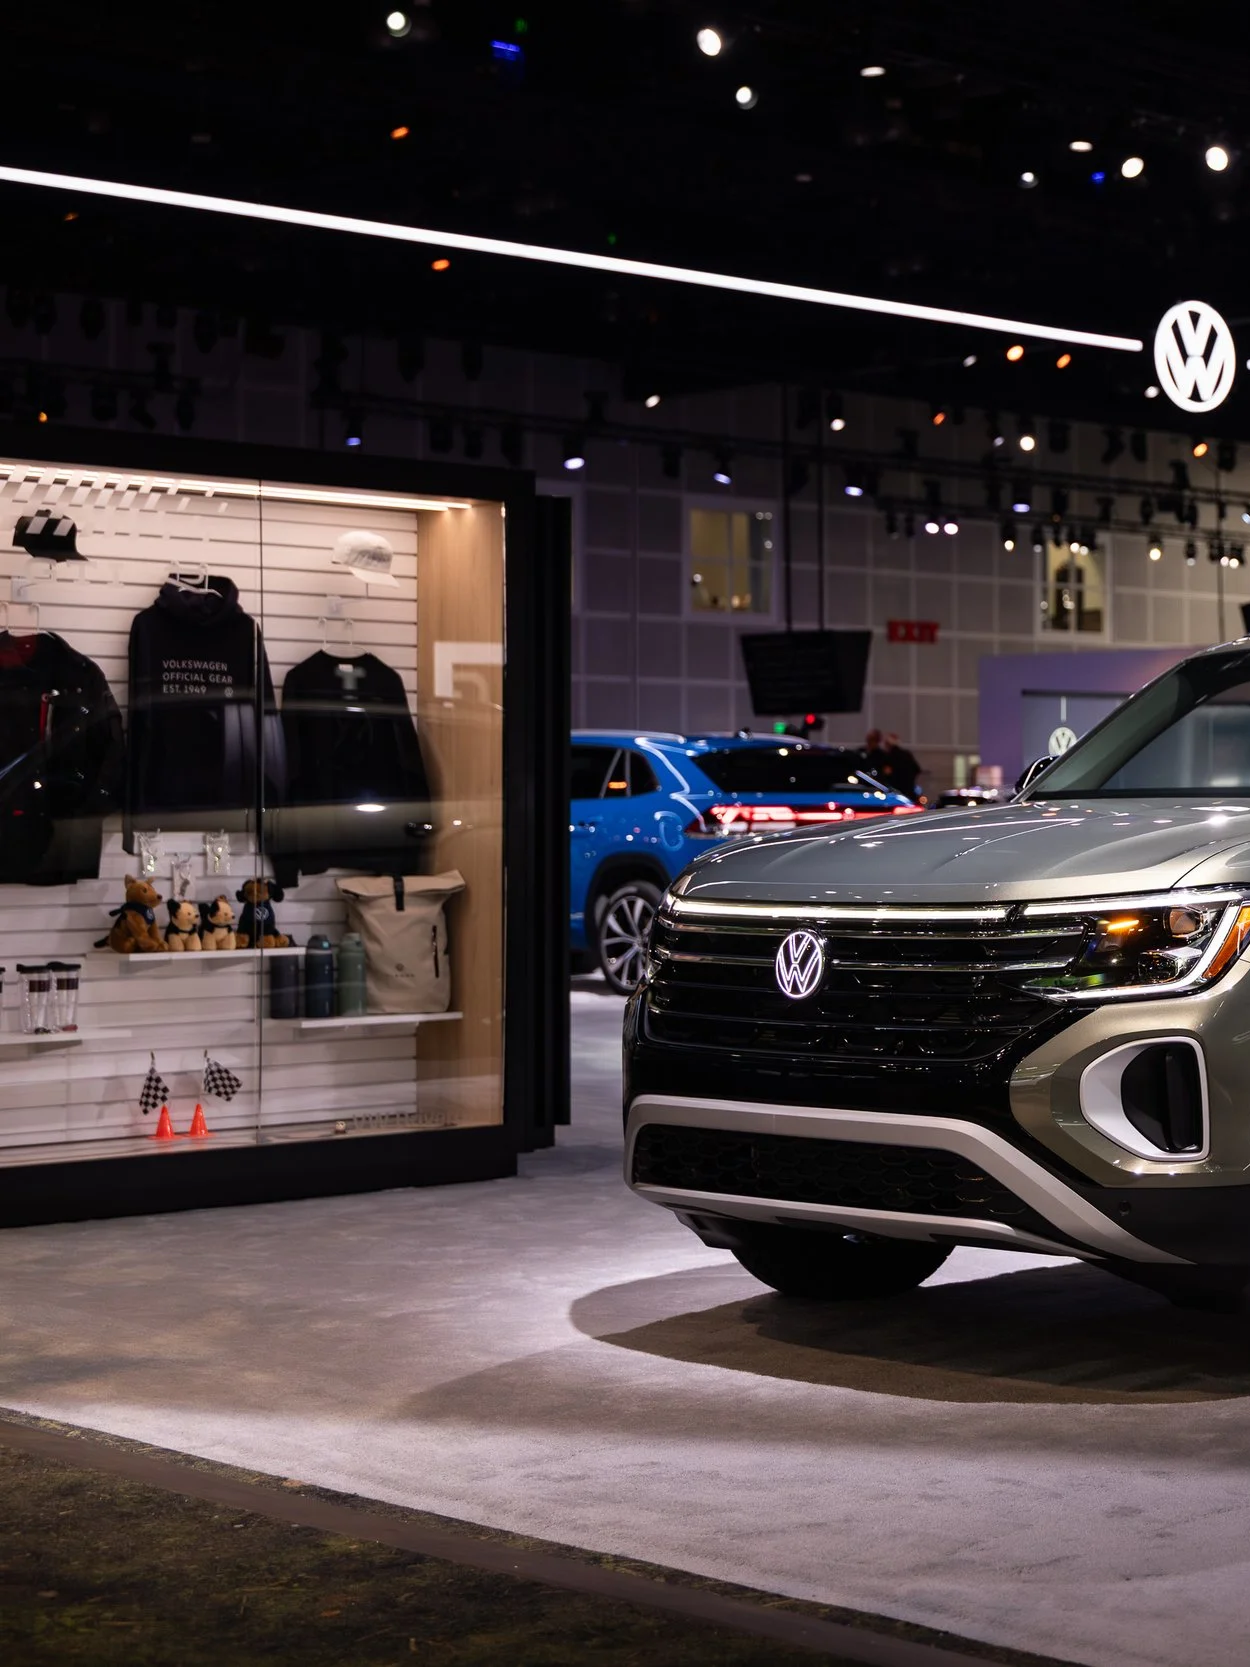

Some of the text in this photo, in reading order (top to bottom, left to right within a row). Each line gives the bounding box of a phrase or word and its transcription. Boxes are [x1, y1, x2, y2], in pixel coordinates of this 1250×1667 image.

[1154, 300, 1236, 412] VW
[162, 660, 228, 671] VOLKSWAGEN
[162, 672, 233, 684] OFFICIAL GEAR
[163, 684, 181, 694] EST.
[775, 931, 823, 998] VW
